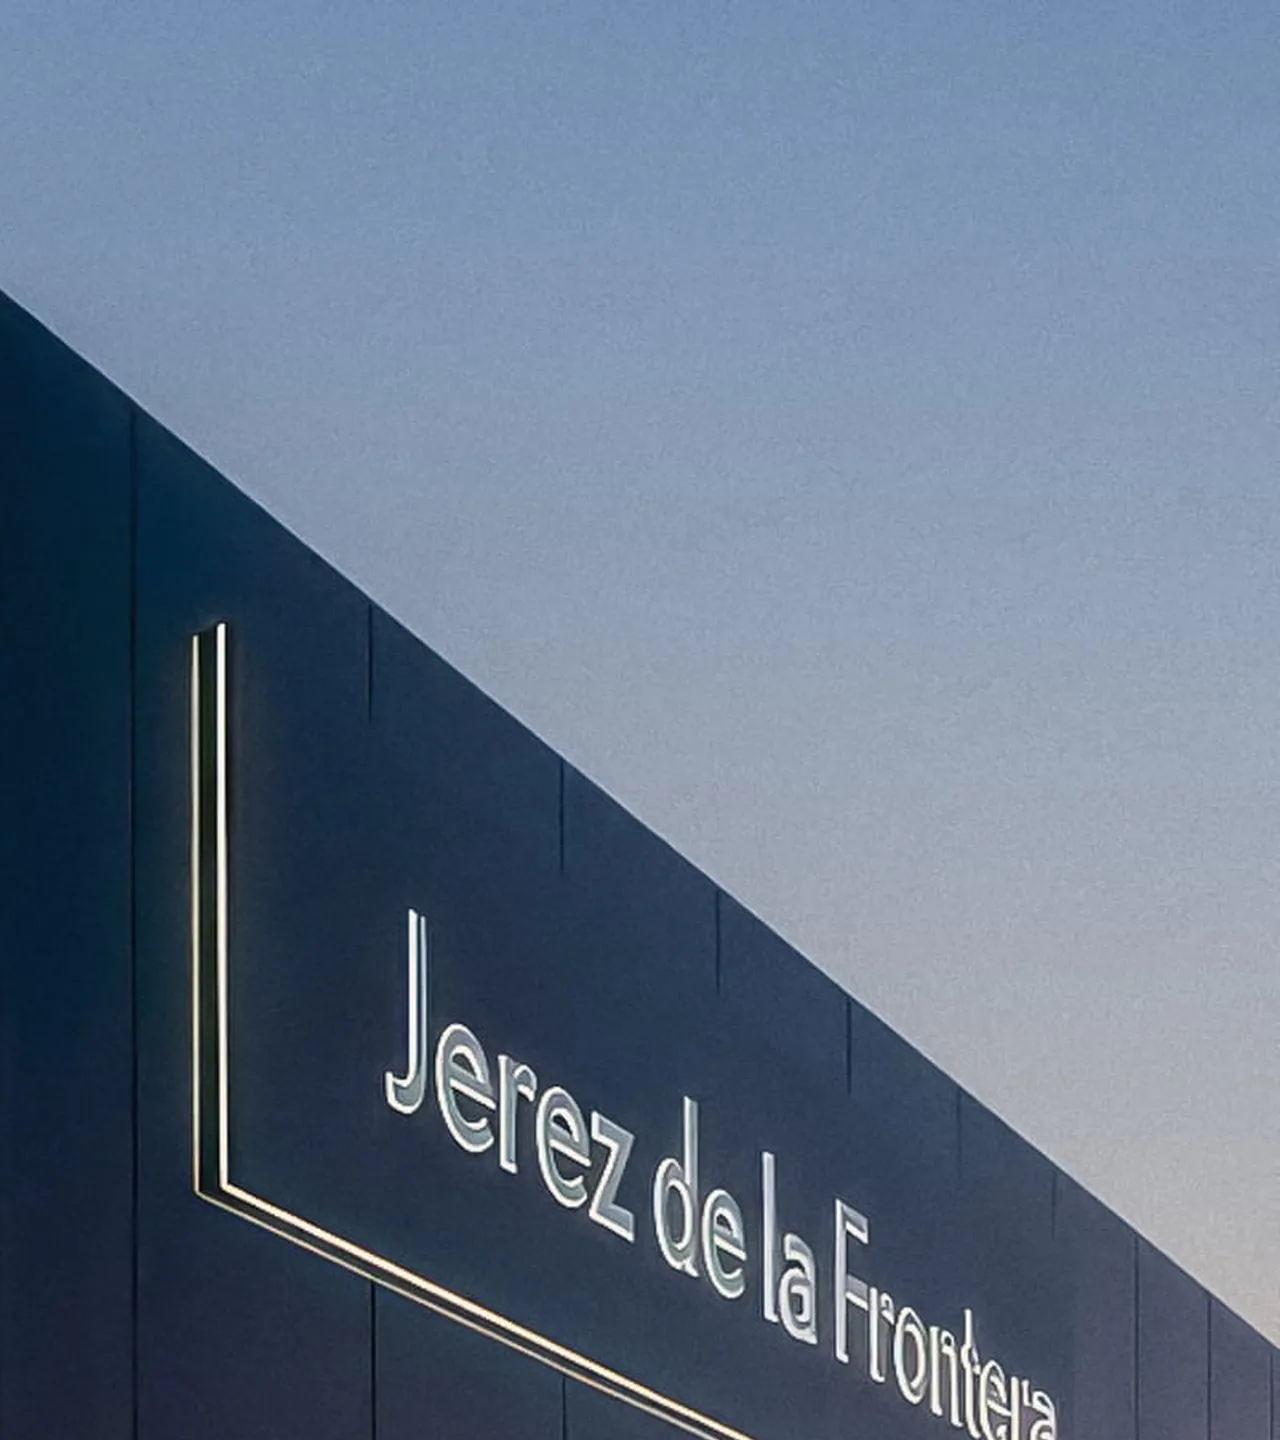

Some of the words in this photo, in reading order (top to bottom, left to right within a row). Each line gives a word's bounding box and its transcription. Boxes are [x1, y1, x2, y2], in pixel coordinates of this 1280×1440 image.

[385, 908, 635, 1242] Jerez
[653, 1096, 748, 1299] de
[762, 1151, 819, 1345] la
